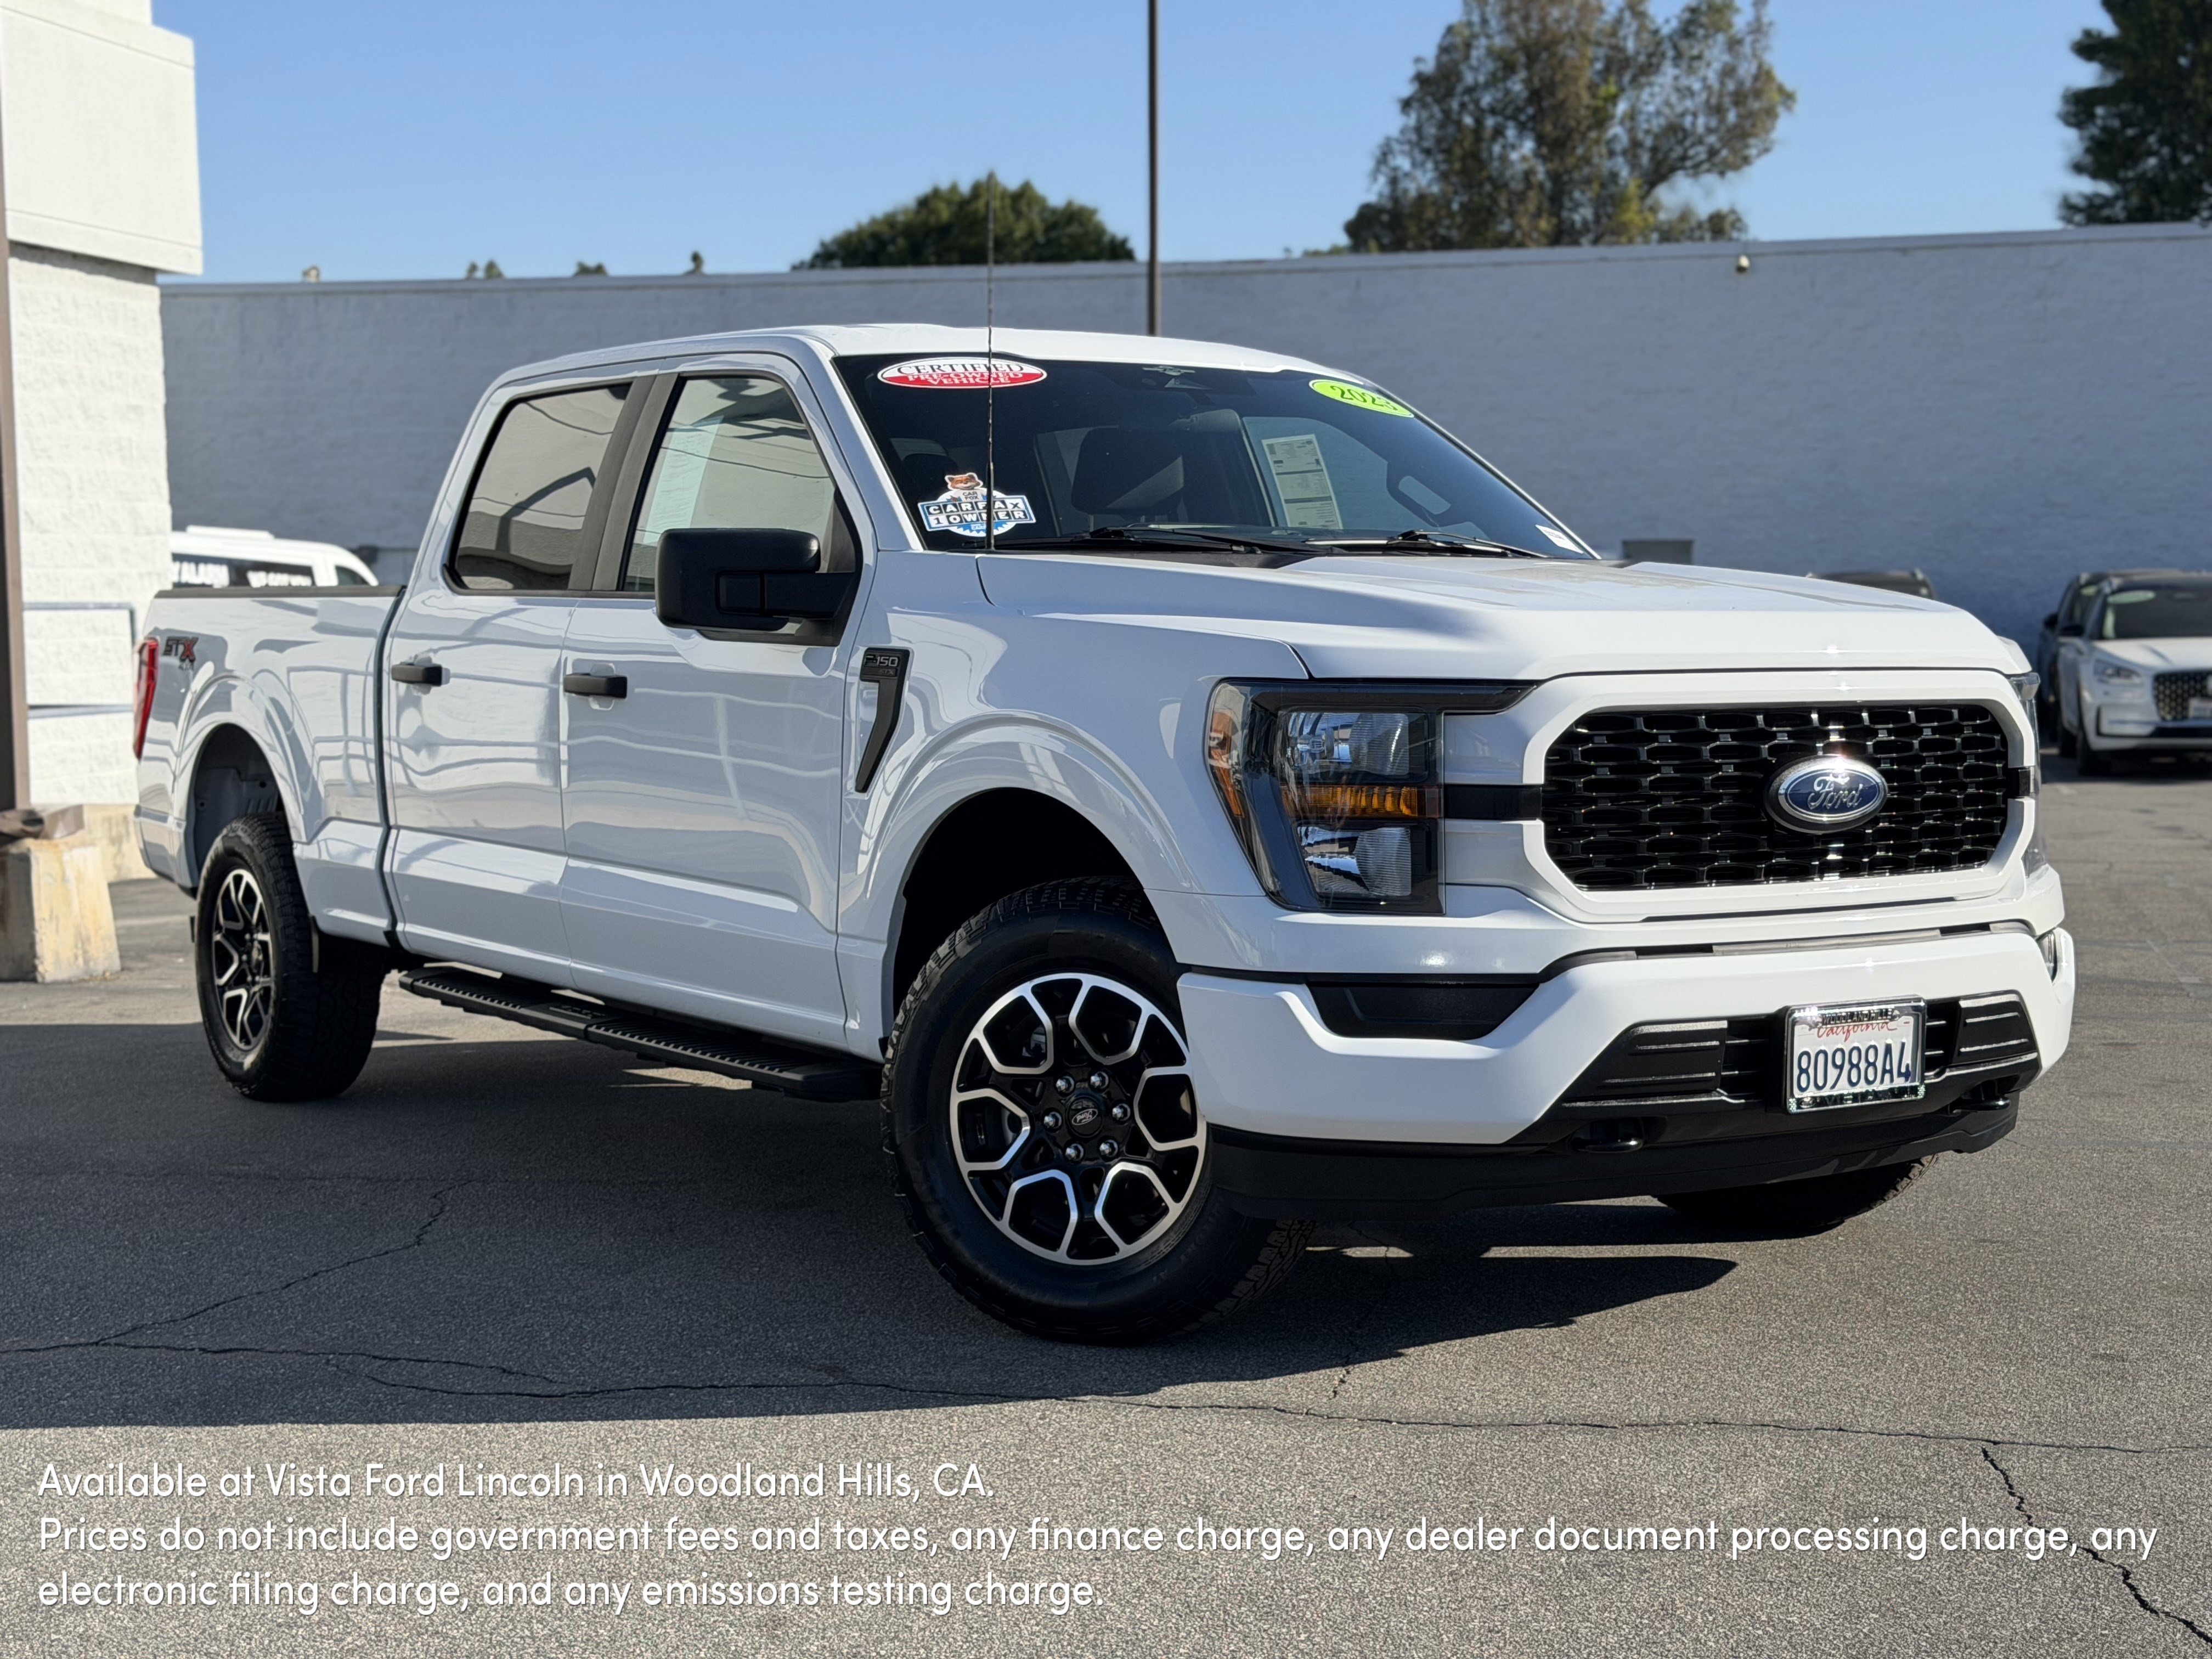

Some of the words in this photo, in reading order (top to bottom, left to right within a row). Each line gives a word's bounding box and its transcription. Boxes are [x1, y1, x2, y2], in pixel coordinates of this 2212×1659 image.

[927, 376, 1010, 385] VEHICLE
[1330, 386, 1398, 410] 2023
[928, 500, 1022, 515] CARFAX
[933, 517, 943, 526] 1
[163, 636, 199, 662] STX
[865, 655, 898, 667] F-150
[1807, 773, 1863, 810] Ford
[1797, 1042, 1911, 1092] 80988A4
[1076, 1110, 1093, 1122] Ford
